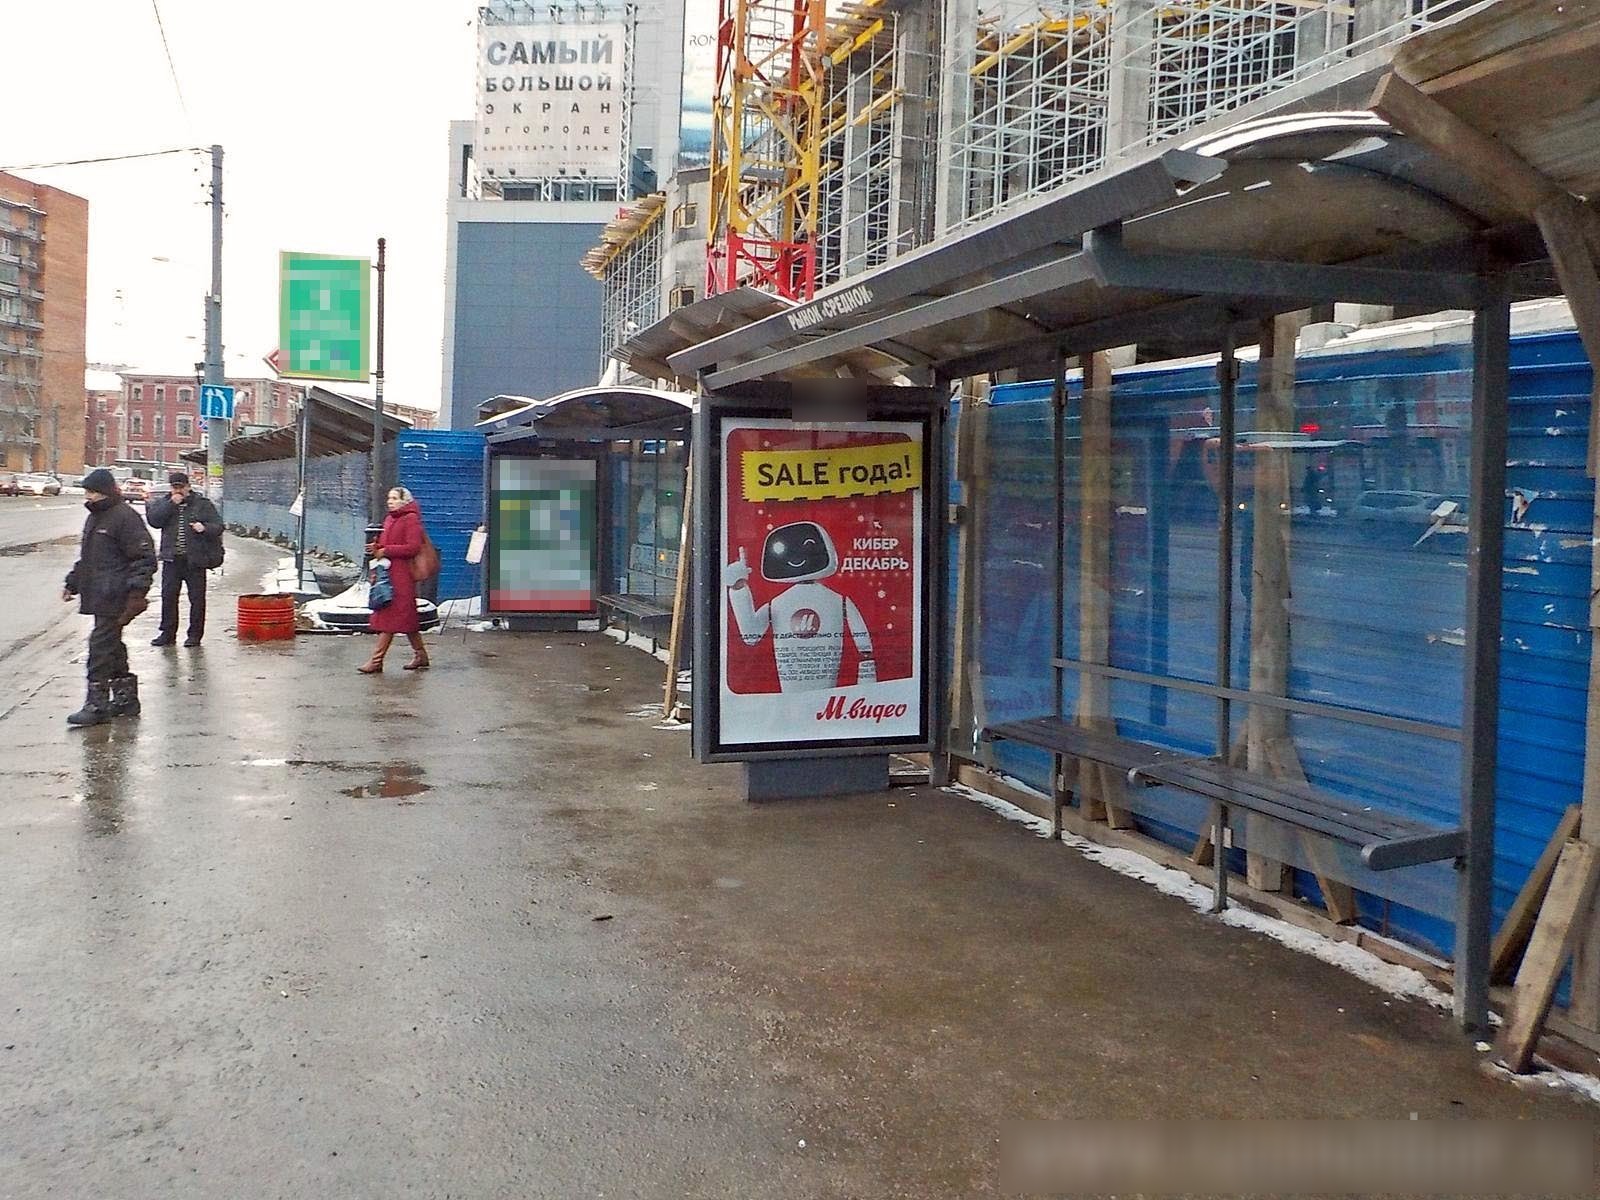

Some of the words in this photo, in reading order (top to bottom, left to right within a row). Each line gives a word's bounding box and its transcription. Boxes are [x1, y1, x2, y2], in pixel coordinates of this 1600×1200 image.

[487, 33, 613, 66] САМЫЙ
[486, 73, 612, 93] БОЛЬШОЙ
[485, 102, 611, 116] ЭКРАН
[504, 125, 611, 136] ГОРОДЕ
[787, 304, 824, 330] РЫНОК
[757, 462, 830, 487] SALE
[838, 454, 912, 485] года!
[853, 537, 899, 550] КИБЕР
[841, 557, 910, 572] ДЕКАБРЬ
